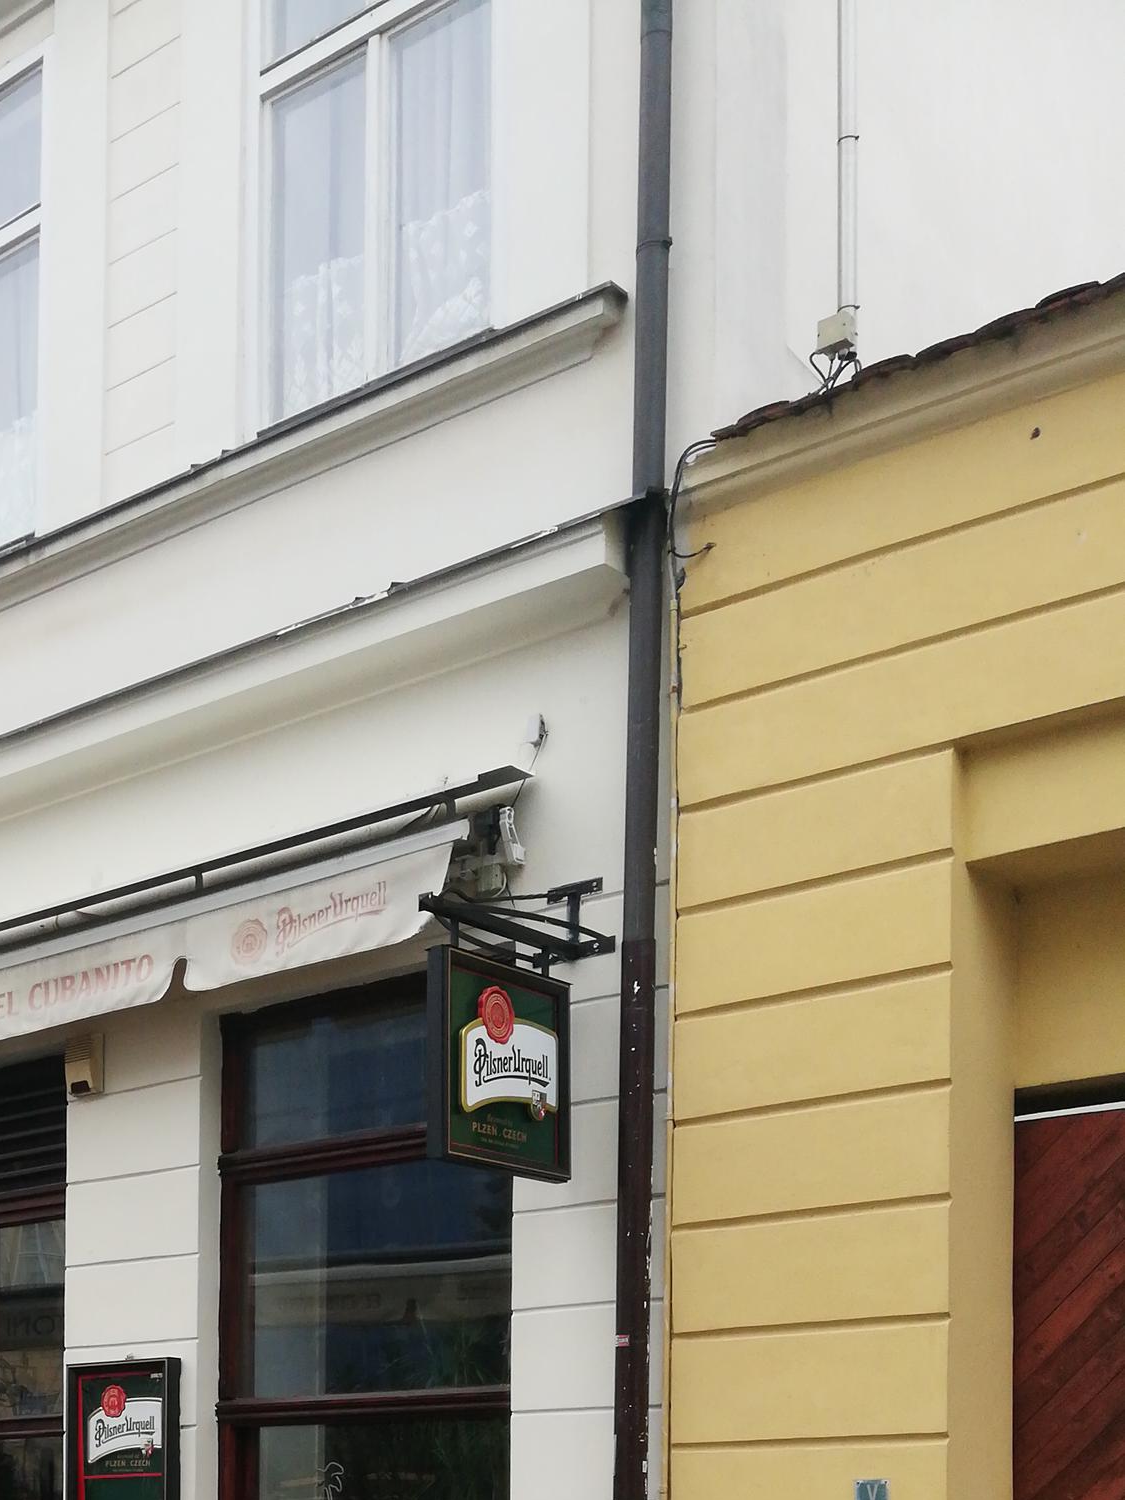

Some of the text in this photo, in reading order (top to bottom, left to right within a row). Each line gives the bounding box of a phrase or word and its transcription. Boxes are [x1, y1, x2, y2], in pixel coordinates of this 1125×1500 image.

[275, 881, 386, 955] Pilsner Urquell
[28, 954, 154, 1010] CUBANITO
[474, 1038, 550, 1087] Pilsner Urquell
[94, 1415, 156, 1448] Pilsner Urquell
